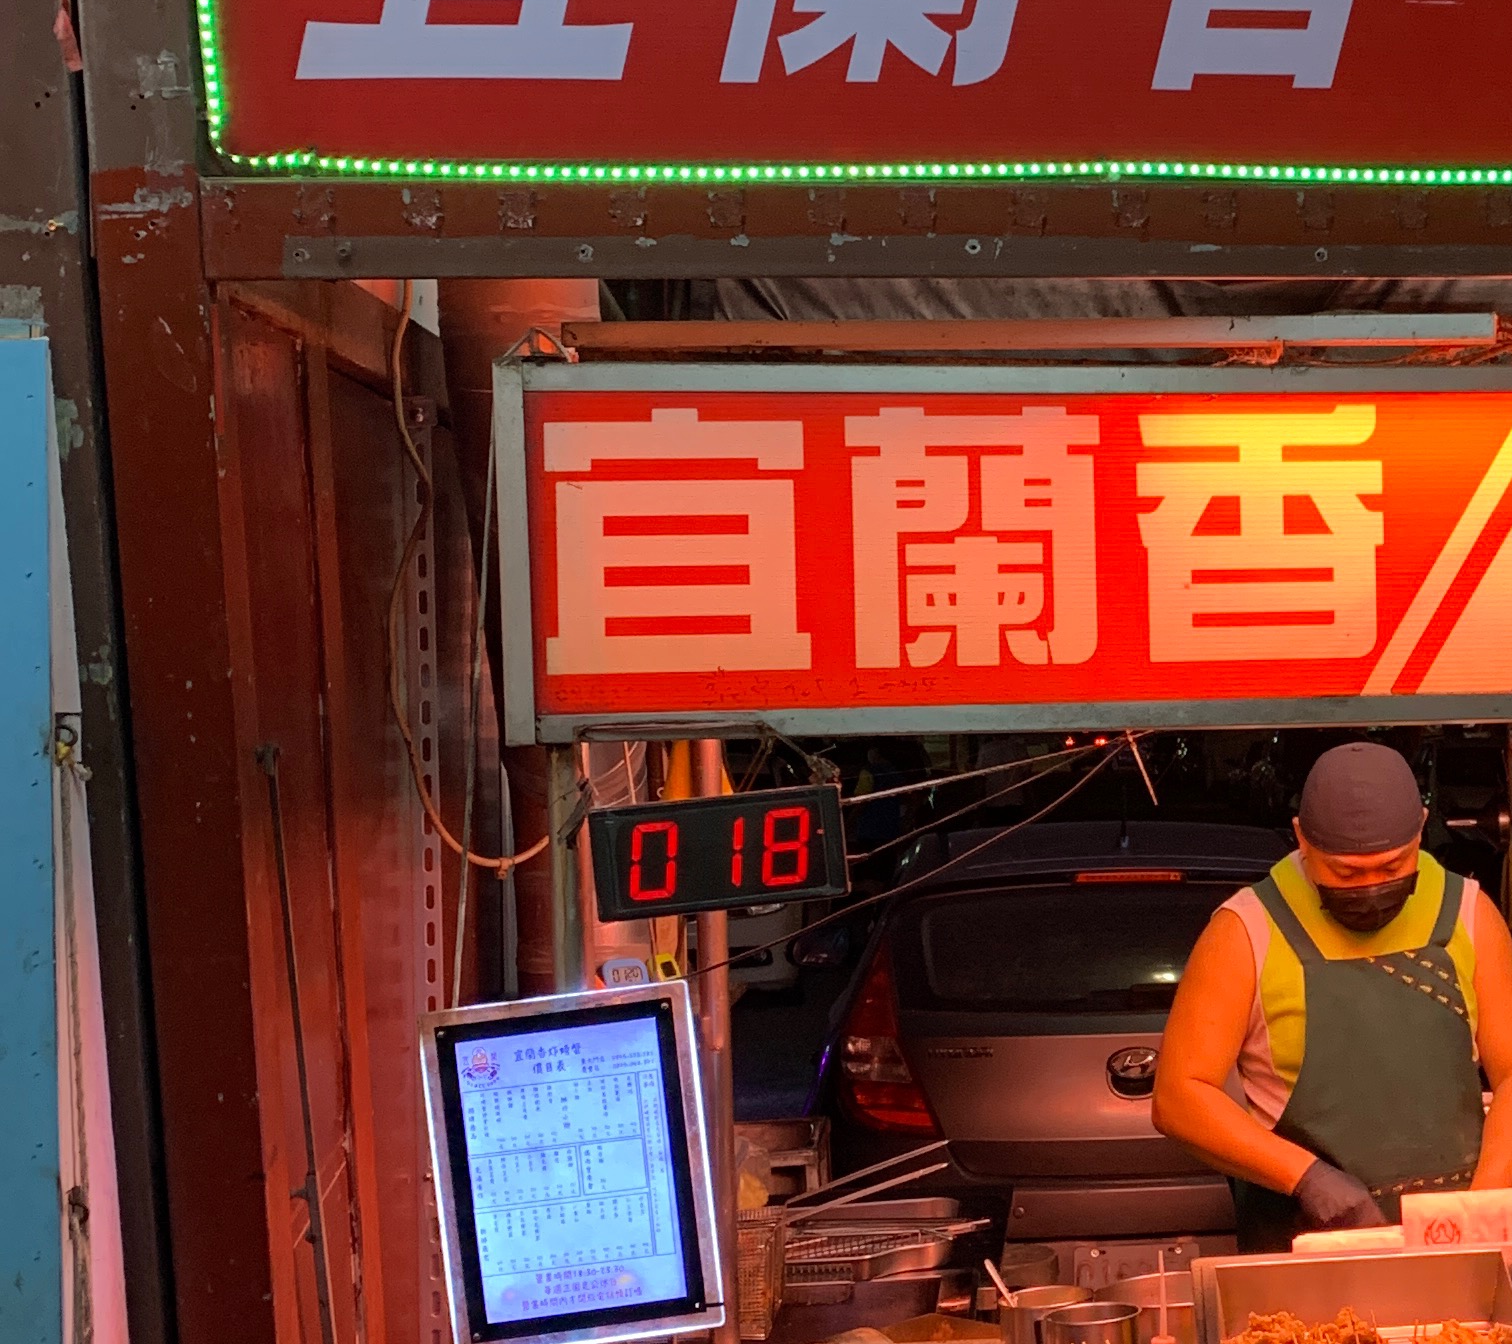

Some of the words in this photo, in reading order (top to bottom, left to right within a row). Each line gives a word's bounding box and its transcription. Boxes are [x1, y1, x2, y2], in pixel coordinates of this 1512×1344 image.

[543, 404, 1385, 675] 宜蘭香
[629, 806, 810, 902] 018
